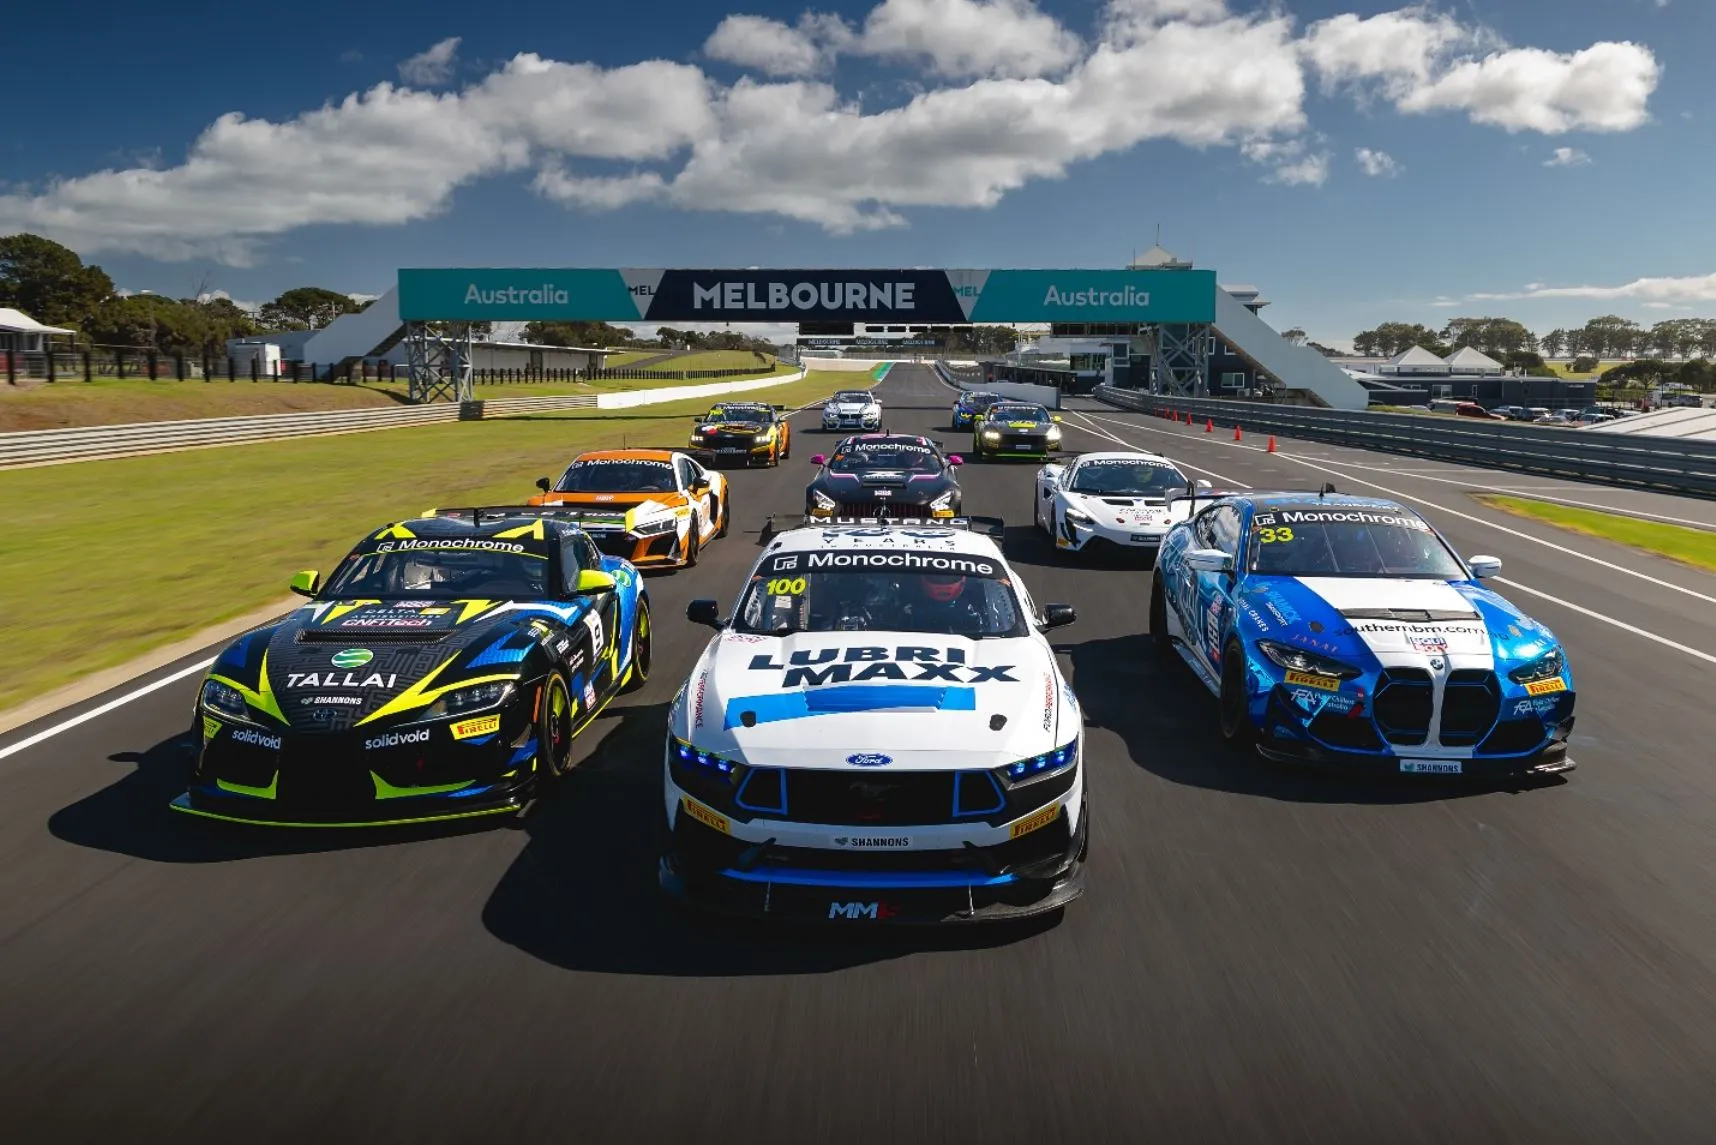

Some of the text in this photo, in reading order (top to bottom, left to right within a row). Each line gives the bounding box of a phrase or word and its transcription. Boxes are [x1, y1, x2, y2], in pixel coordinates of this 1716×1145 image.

[464, 283, 569, 305] Australia
[693, 282, 915, 310] MELBOURNE
[1044, 283, 1151, 306] Australia
[855, 443, 931, 454] Monochrome
[587, 459, 673, 470] Monochrome
[810, 516, 967, 525] MUSTANG
[1282, 511, 1428, 529] Monochrome
[1259, 527, 1295, 544] 33
[399, 538, 525, 553] Monochrome
[808, 552, 993, 574] Monochrome
[767, 577, 806, 595] 100
[748, 646, 966, 670] LUBRI
[286, 672, 397, 688] TALLAI
[782, 662, 1020, 688] MAXX
[314, 696, 363, 705] SHANNONS
[457, 717, 497, 735] PIRELLI
[232, 729, 282, 749] solidvoid
[365, 728, 430, 750] solidvoid
[855, 754, 884, 764] Ford
[1416, 763, 1459, 772] SHANNONS
[687, 799, 726, 831] PIRELLI
[1014, 806, 1056, 837] PIRELLI
[852, 837, 909, 847] SHANNONS
